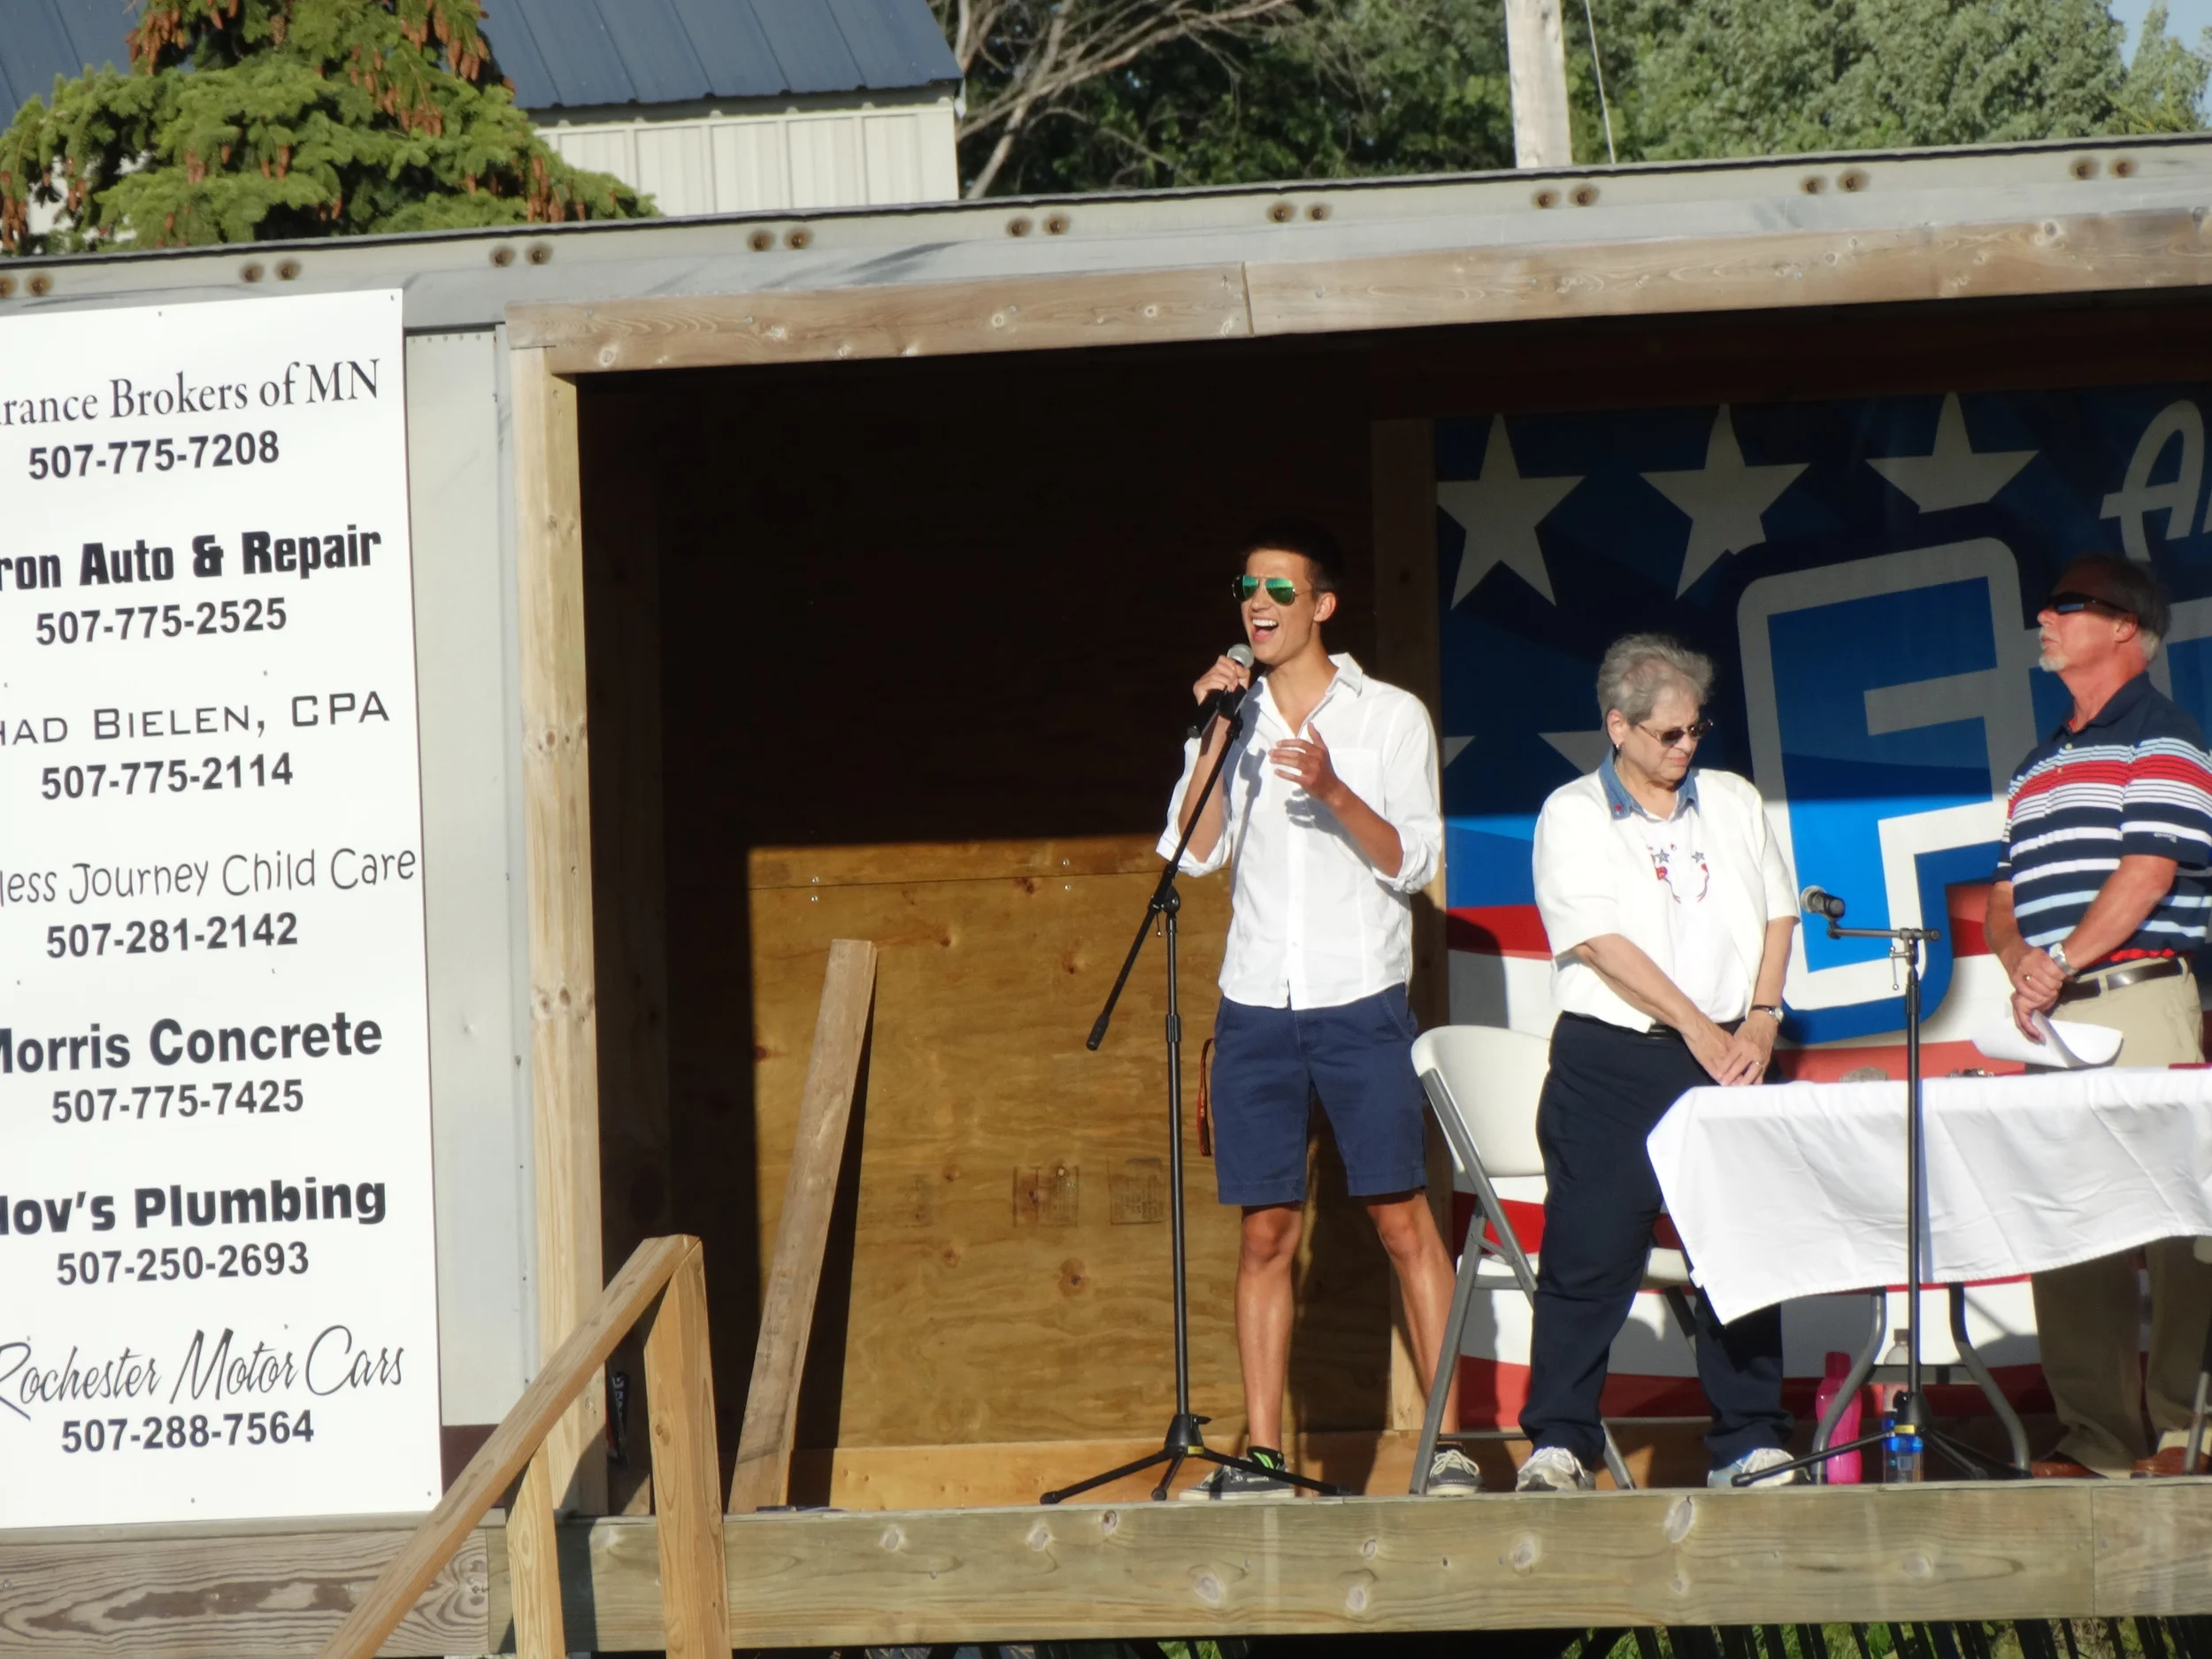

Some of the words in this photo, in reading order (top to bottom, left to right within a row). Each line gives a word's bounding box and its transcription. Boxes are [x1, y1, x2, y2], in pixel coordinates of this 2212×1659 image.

[0, 395, 99, 426] rance
[110, 371, 249, 419] Brokers
[259, 361, 300, 408] of
[305, 358, 380, 403] MN
[28, 430, 280, 480] 507-775-7208
[2099, 399, 2212, 561] A
[80, 539, 174, 586] Auto
[191, 534, 224, 578] &
[242, 524, 382, 580] Repair
[35, 597, 288, 645] 507-775-2525
[0, 717, 68, 746] AD
[94, 704, 267, 740] BIELEN,
[290, 690, 390, 728] CPA
[42, 752, 293, 800] 507-775-2114
[0, 870, 57, 907] less
[69, 860, 209, 904] Journey
[222, 849, 316, 895] Child
[330, 848, 416, 890] Care
[46, 912, 298, 959] 507-281-2142
[150, 1011, 382, 1066] Concrete
[51, 1079, 303, 1124] 507-775-7425
[134, 1177, 387, 1229] Plumbing
[56, 1240, 309, 1286] 507-250-2693
[169, 1327, 298, 1405] Motor
[305, 1325, 405, 1396] Cars
[61, 1409, 314, 1454] 507-288-7564
